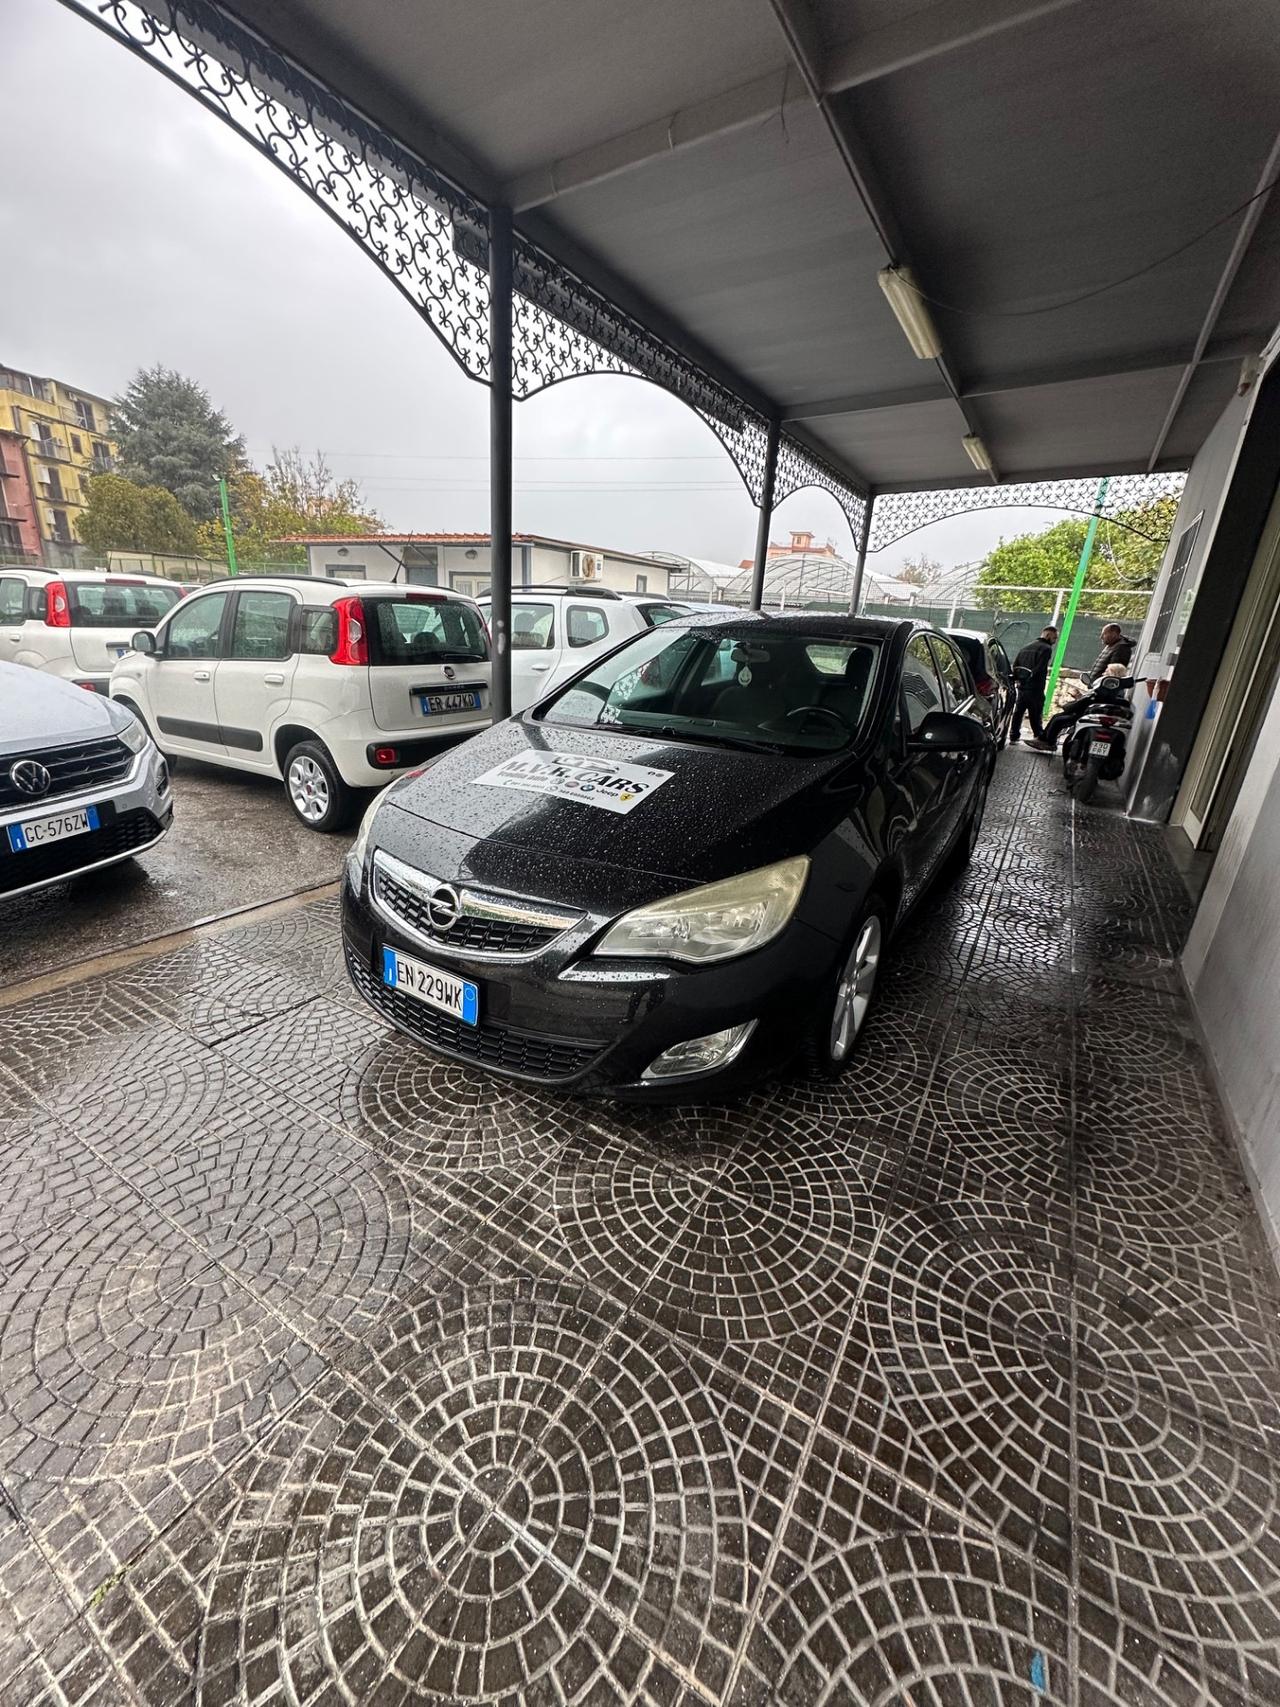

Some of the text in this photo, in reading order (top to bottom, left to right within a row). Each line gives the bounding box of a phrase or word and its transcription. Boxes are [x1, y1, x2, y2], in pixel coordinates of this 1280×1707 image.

[502, 761, 649, 794] M.V.R. CARS
[596, 789, 619, 797] Jeep
[397, 961, 414, 987] EN
[418, 970, 462, 1011] 229WK
